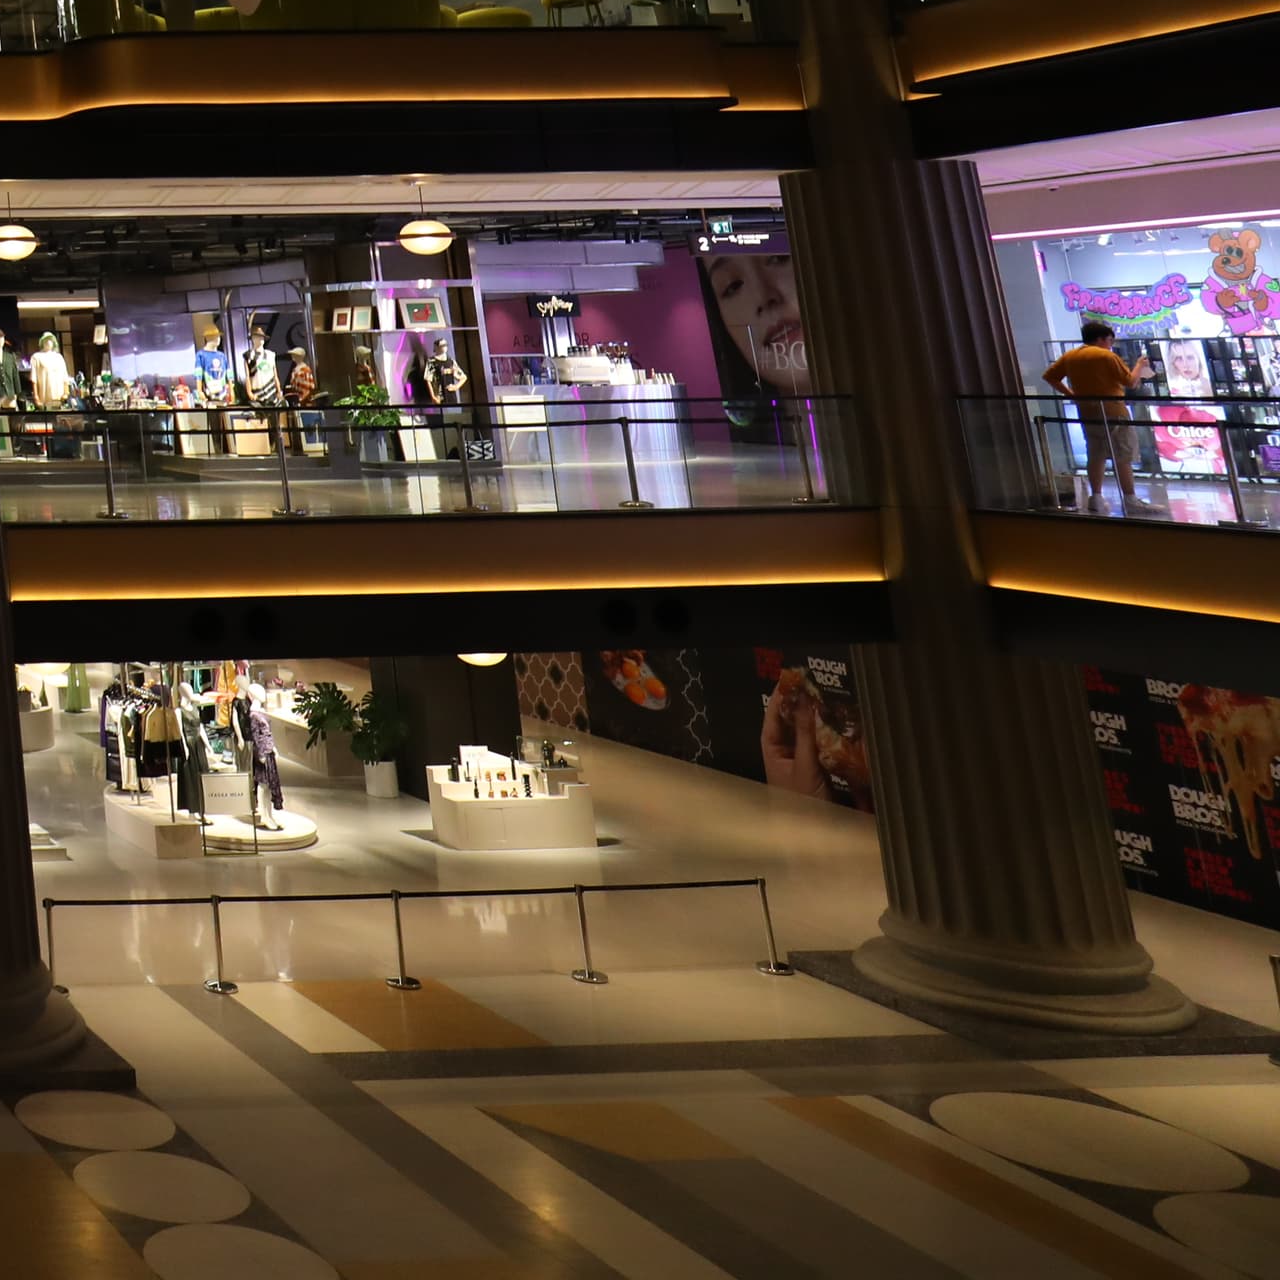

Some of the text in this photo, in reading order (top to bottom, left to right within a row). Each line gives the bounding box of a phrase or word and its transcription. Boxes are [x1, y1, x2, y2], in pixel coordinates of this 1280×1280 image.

[698, 236, 710, 252] 2
[1061, 274, 1189, 319] FRAGRANCE
[808, 656, 847, 676] DOUGH
[1146, 679, 1185, 699] BRO
[1090, 710, 1127, 732] UGH
[1168, 783, 1226, 812] DOUGH
[1114, 830, 1153, 852] UGH
